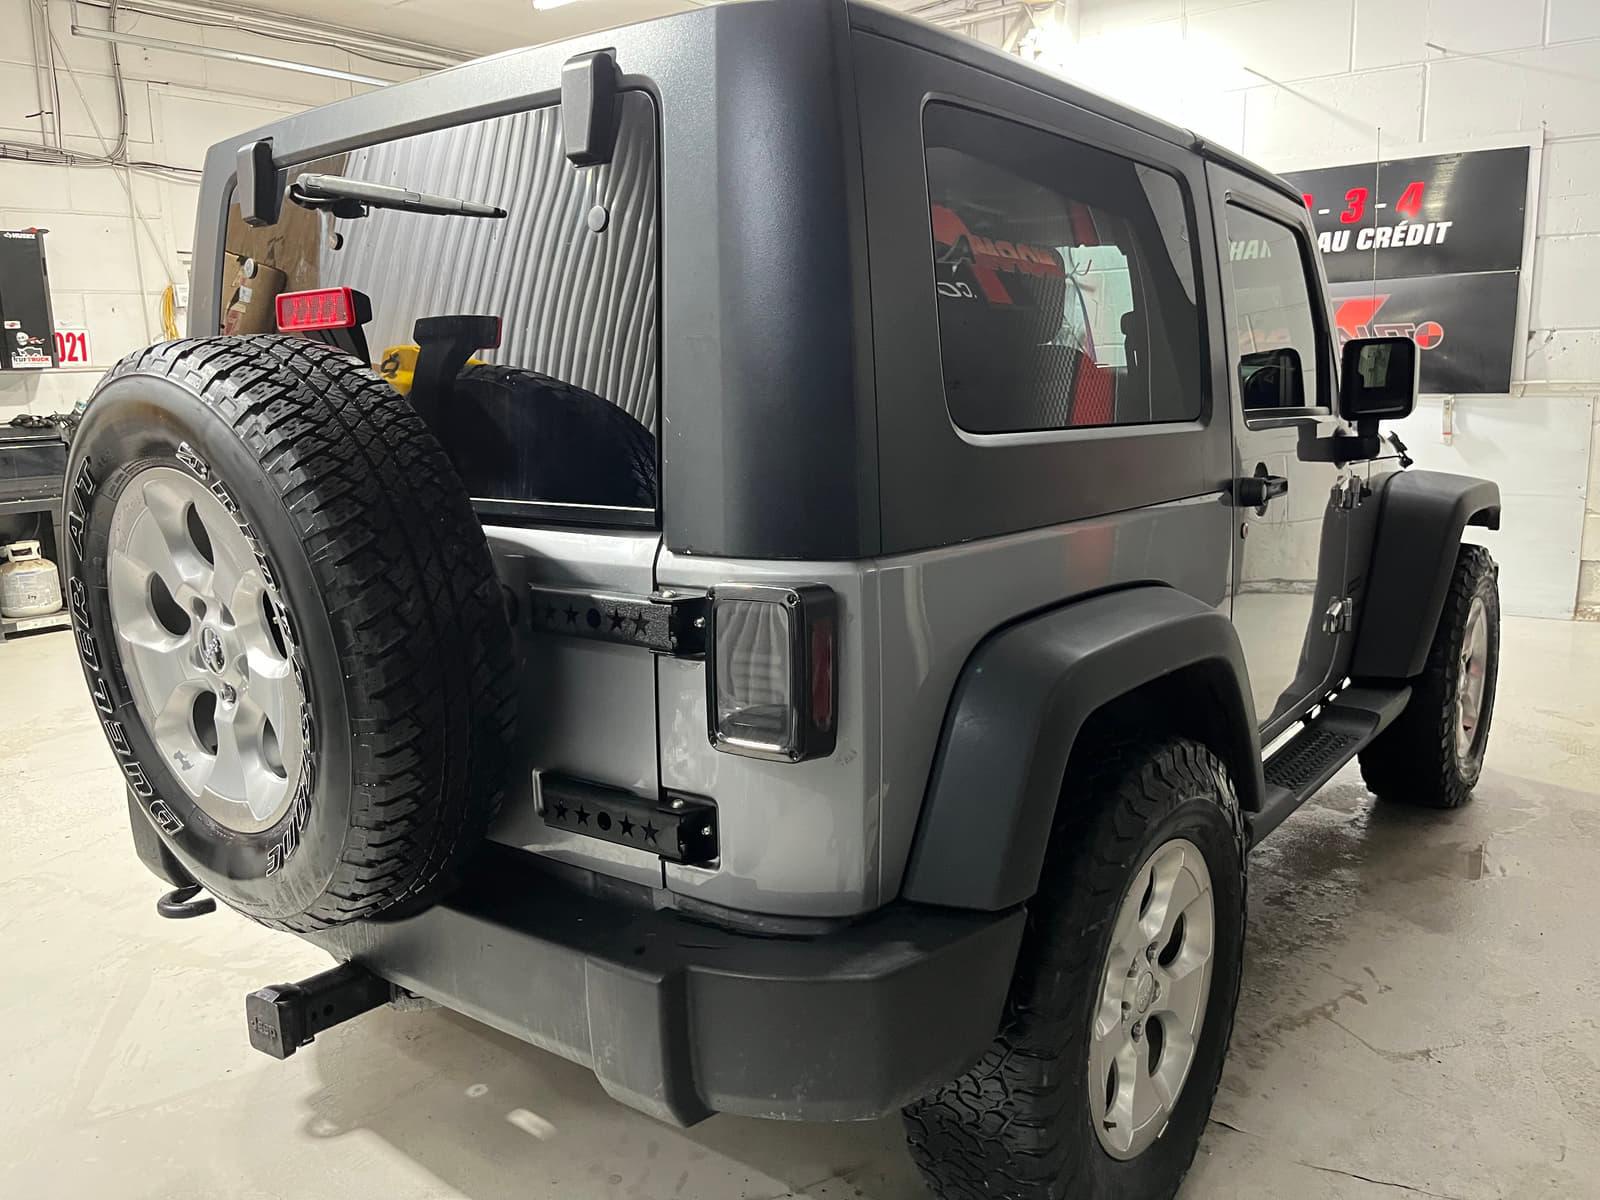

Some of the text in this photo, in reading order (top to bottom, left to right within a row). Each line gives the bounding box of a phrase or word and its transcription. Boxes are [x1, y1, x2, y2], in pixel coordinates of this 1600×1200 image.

[1340, 186, 1370, 224] 3
[1395, 181, 1426, 218] 4
[1318, 230, 1351, 254] AU
[1356, 219, 1454, 251] CRÉDIT
[68, 456, 184, 836] DUELER A/T
